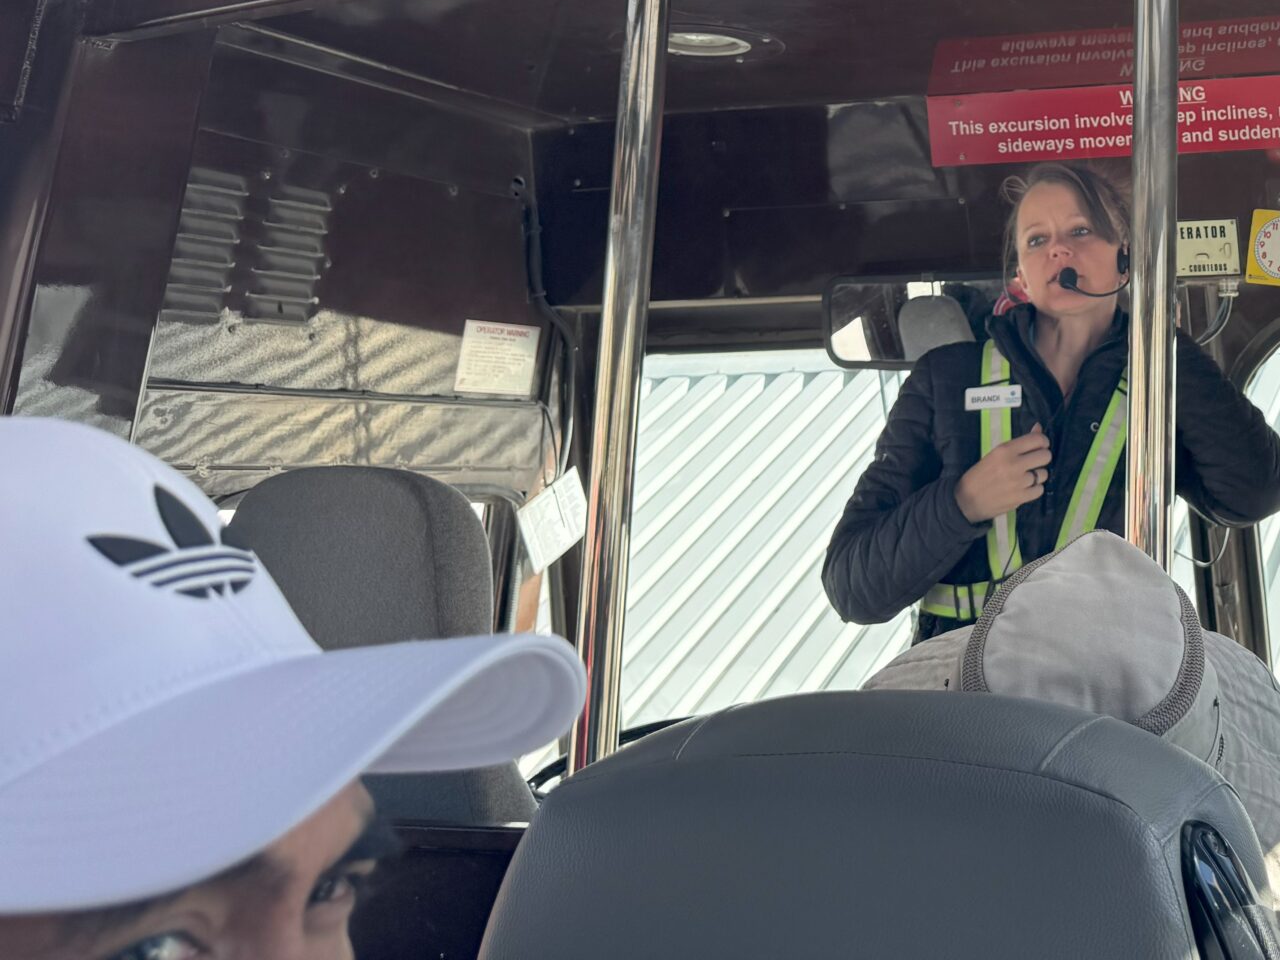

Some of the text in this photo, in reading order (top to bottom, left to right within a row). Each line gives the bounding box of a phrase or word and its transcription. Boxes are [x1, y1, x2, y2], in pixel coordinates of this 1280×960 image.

[949, 120, 984, 136] This
[988, 116, 1070, 134] excursion
[1075, 112, 1133, 130] involve
[1201, 105, 1273, 122] inclines,
[998, 136, 1075, 154] sideways
[1182, 127, 1214, 143] and
[1272, 222, 1279, 230] 11
[1180, 225, 1226, 240] ERATOR
[1263, 230, 1272, 239] 10
[1260, 240, 1265, 248] 9
[1261, 251, 1267, 260] 8
[1188, 263, 1228, 273] COURTEOUS
[1268, 260, 1273, 268] 7
[971, 394, 1001, 404] BRANDI
